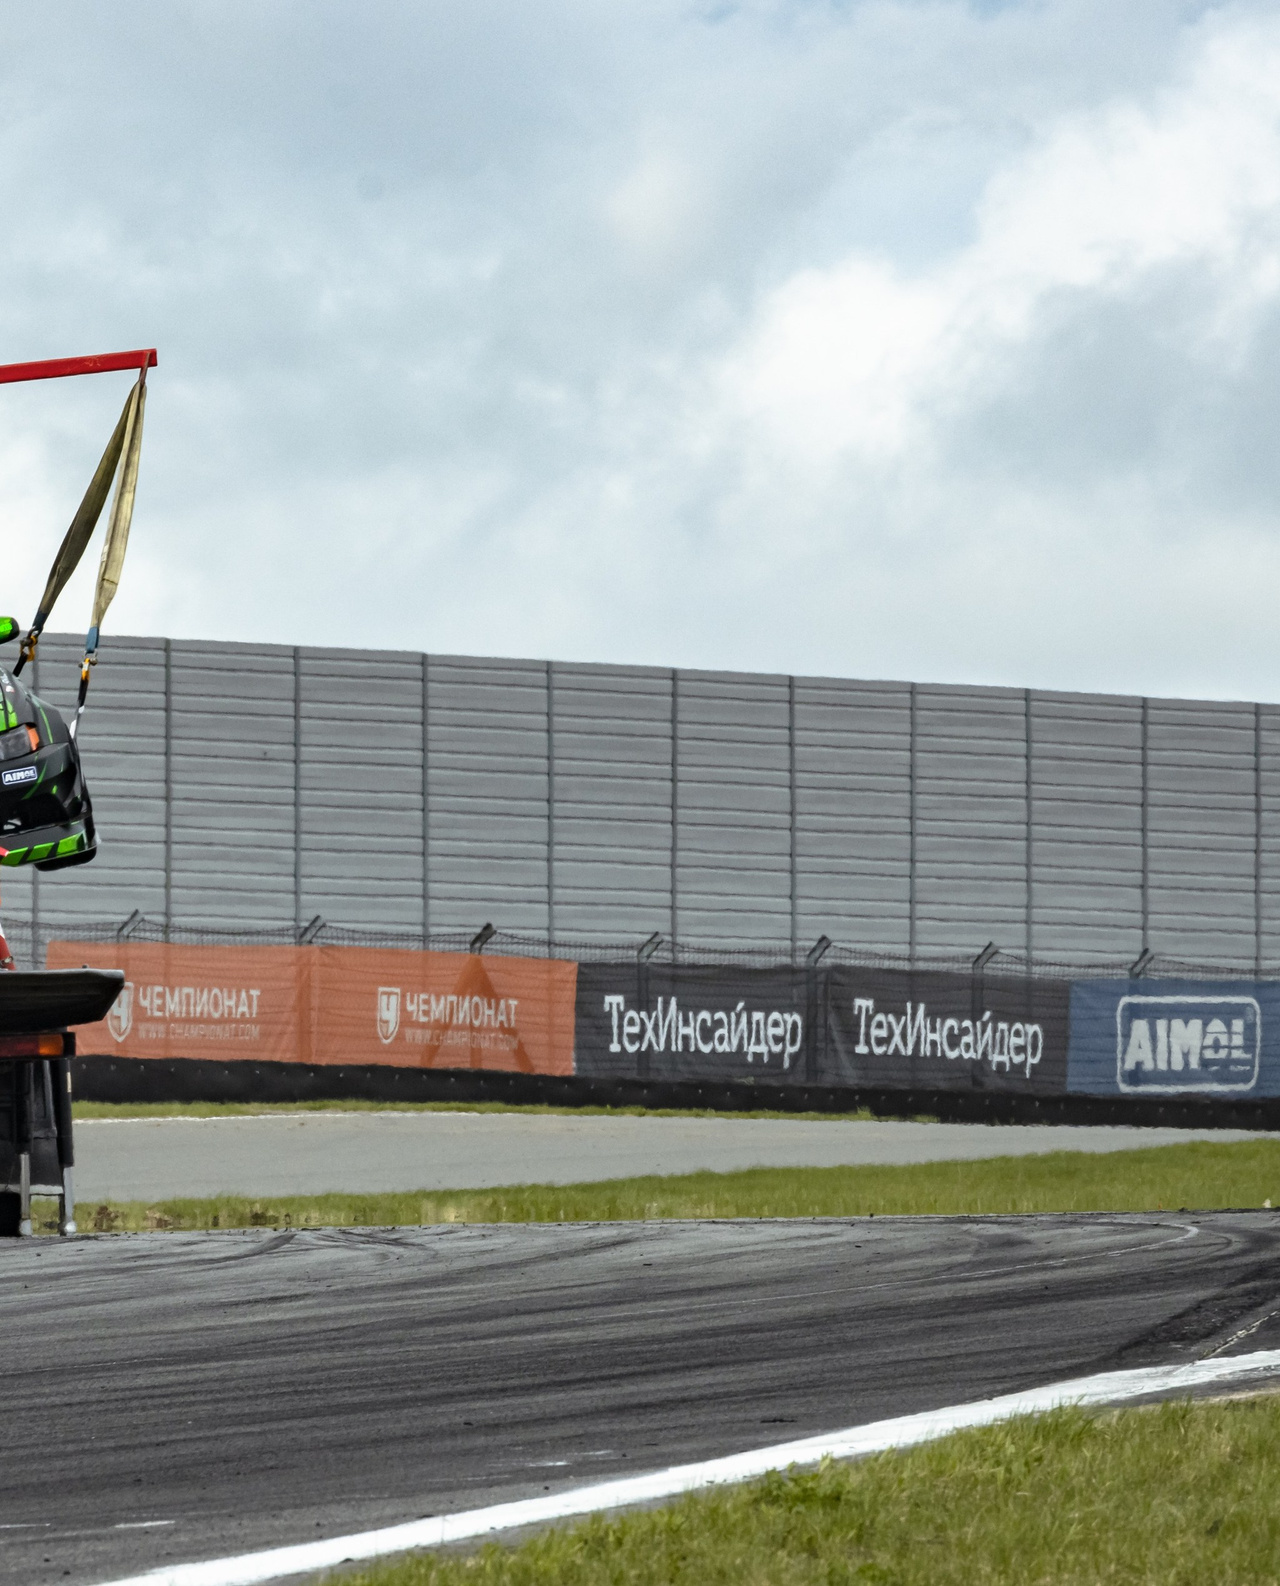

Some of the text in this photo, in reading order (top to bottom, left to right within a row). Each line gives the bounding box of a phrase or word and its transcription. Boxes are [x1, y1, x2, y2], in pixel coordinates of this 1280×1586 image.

[5, 770, 35, 781] AIMOL
[139, 985, 261, 1018] ЧЕМПИОНАТ
[406, 992, 518, 1028] ЧЕМПИОНАТ
[603, 995, 802, 1069] ТехИнсайдер
[853, 997, 1043, 1079] ТехИнсайдер
[1124, 1018, 1253, 1072] AIMOL
